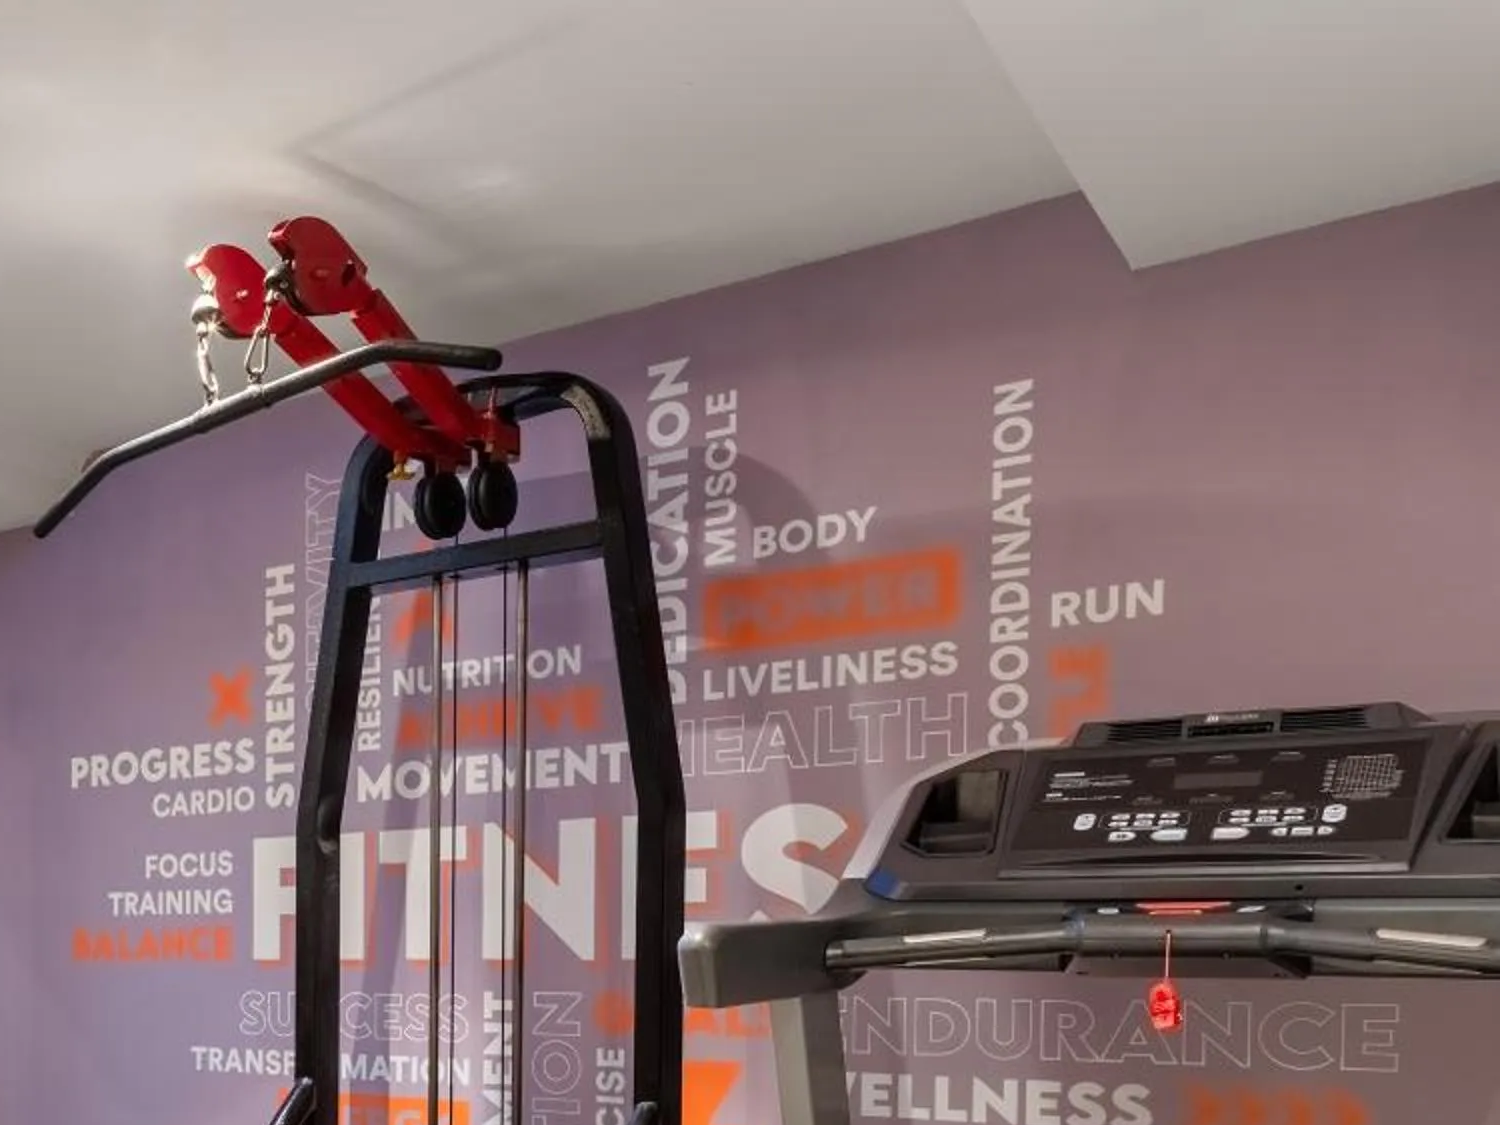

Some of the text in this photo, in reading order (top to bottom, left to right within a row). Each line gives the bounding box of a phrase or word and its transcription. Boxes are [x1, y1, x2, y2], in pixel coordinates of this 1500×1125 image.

[704, 388, 738, 567] MUSCLE
[753, 506, 877, 559] BODY
[1050, 579, 1165, 628] RUN
[265, 563, 296, 808] STRENGTH
[703, 641, 959, 701] LIVELINESS
[71, 738, 255, 790] PROGRESS
[151, 785, 255, 818] CARDIO
[145, 850, 233, 879] FOCUS
[108, 888, 233, 917] TRAINING
[238, 989, 470, 1043] SUCESS
[843, 996, 1401, 1073] NDURANCE
